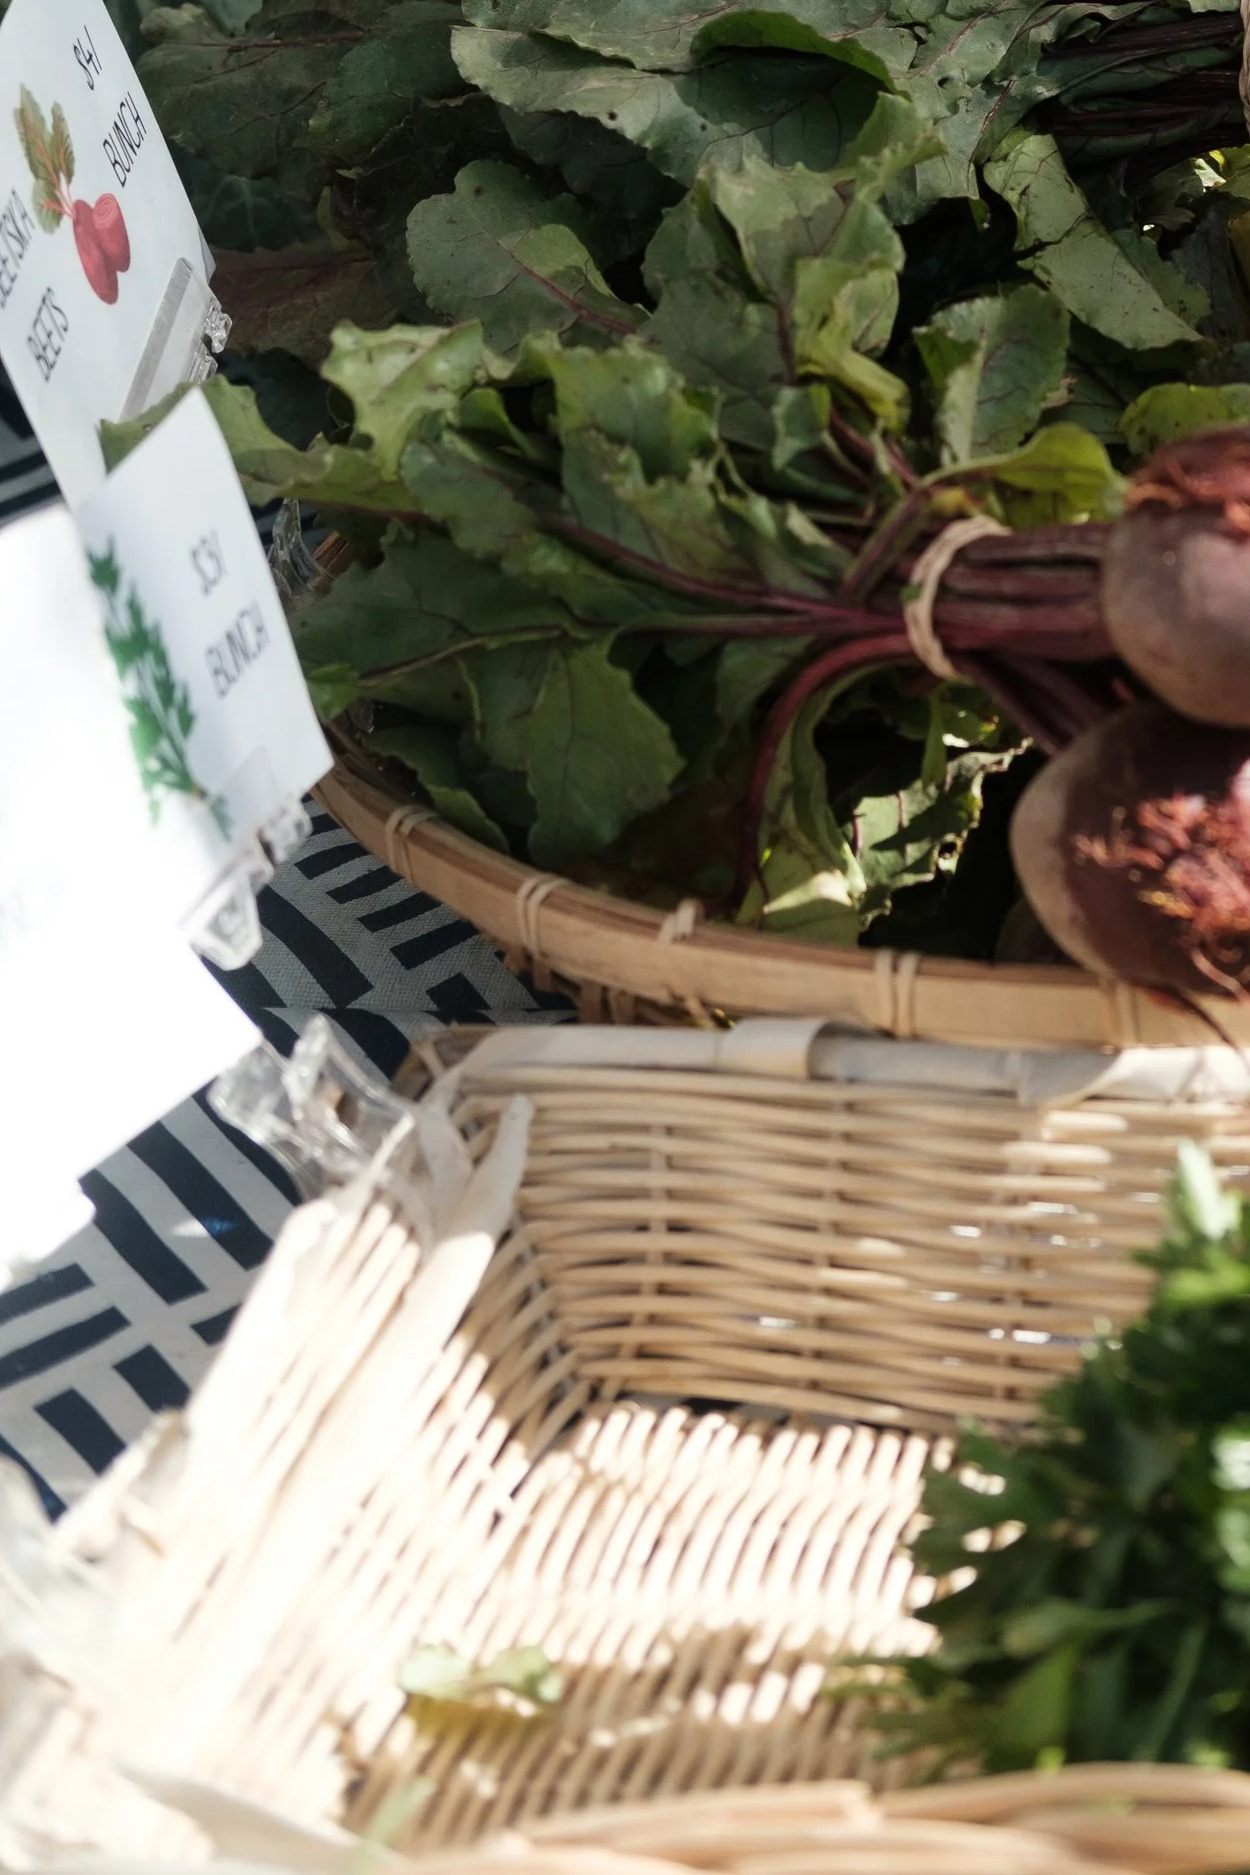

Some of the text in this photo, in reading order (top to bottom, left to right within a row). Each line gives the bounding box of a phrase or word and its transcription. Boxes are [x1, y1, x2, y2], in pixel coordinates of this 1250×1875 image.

[102, 91, 147, 188] BUNCH
[26, 287, 69, 383] BEETS
[205, 599, 271, 700] BUNCH
